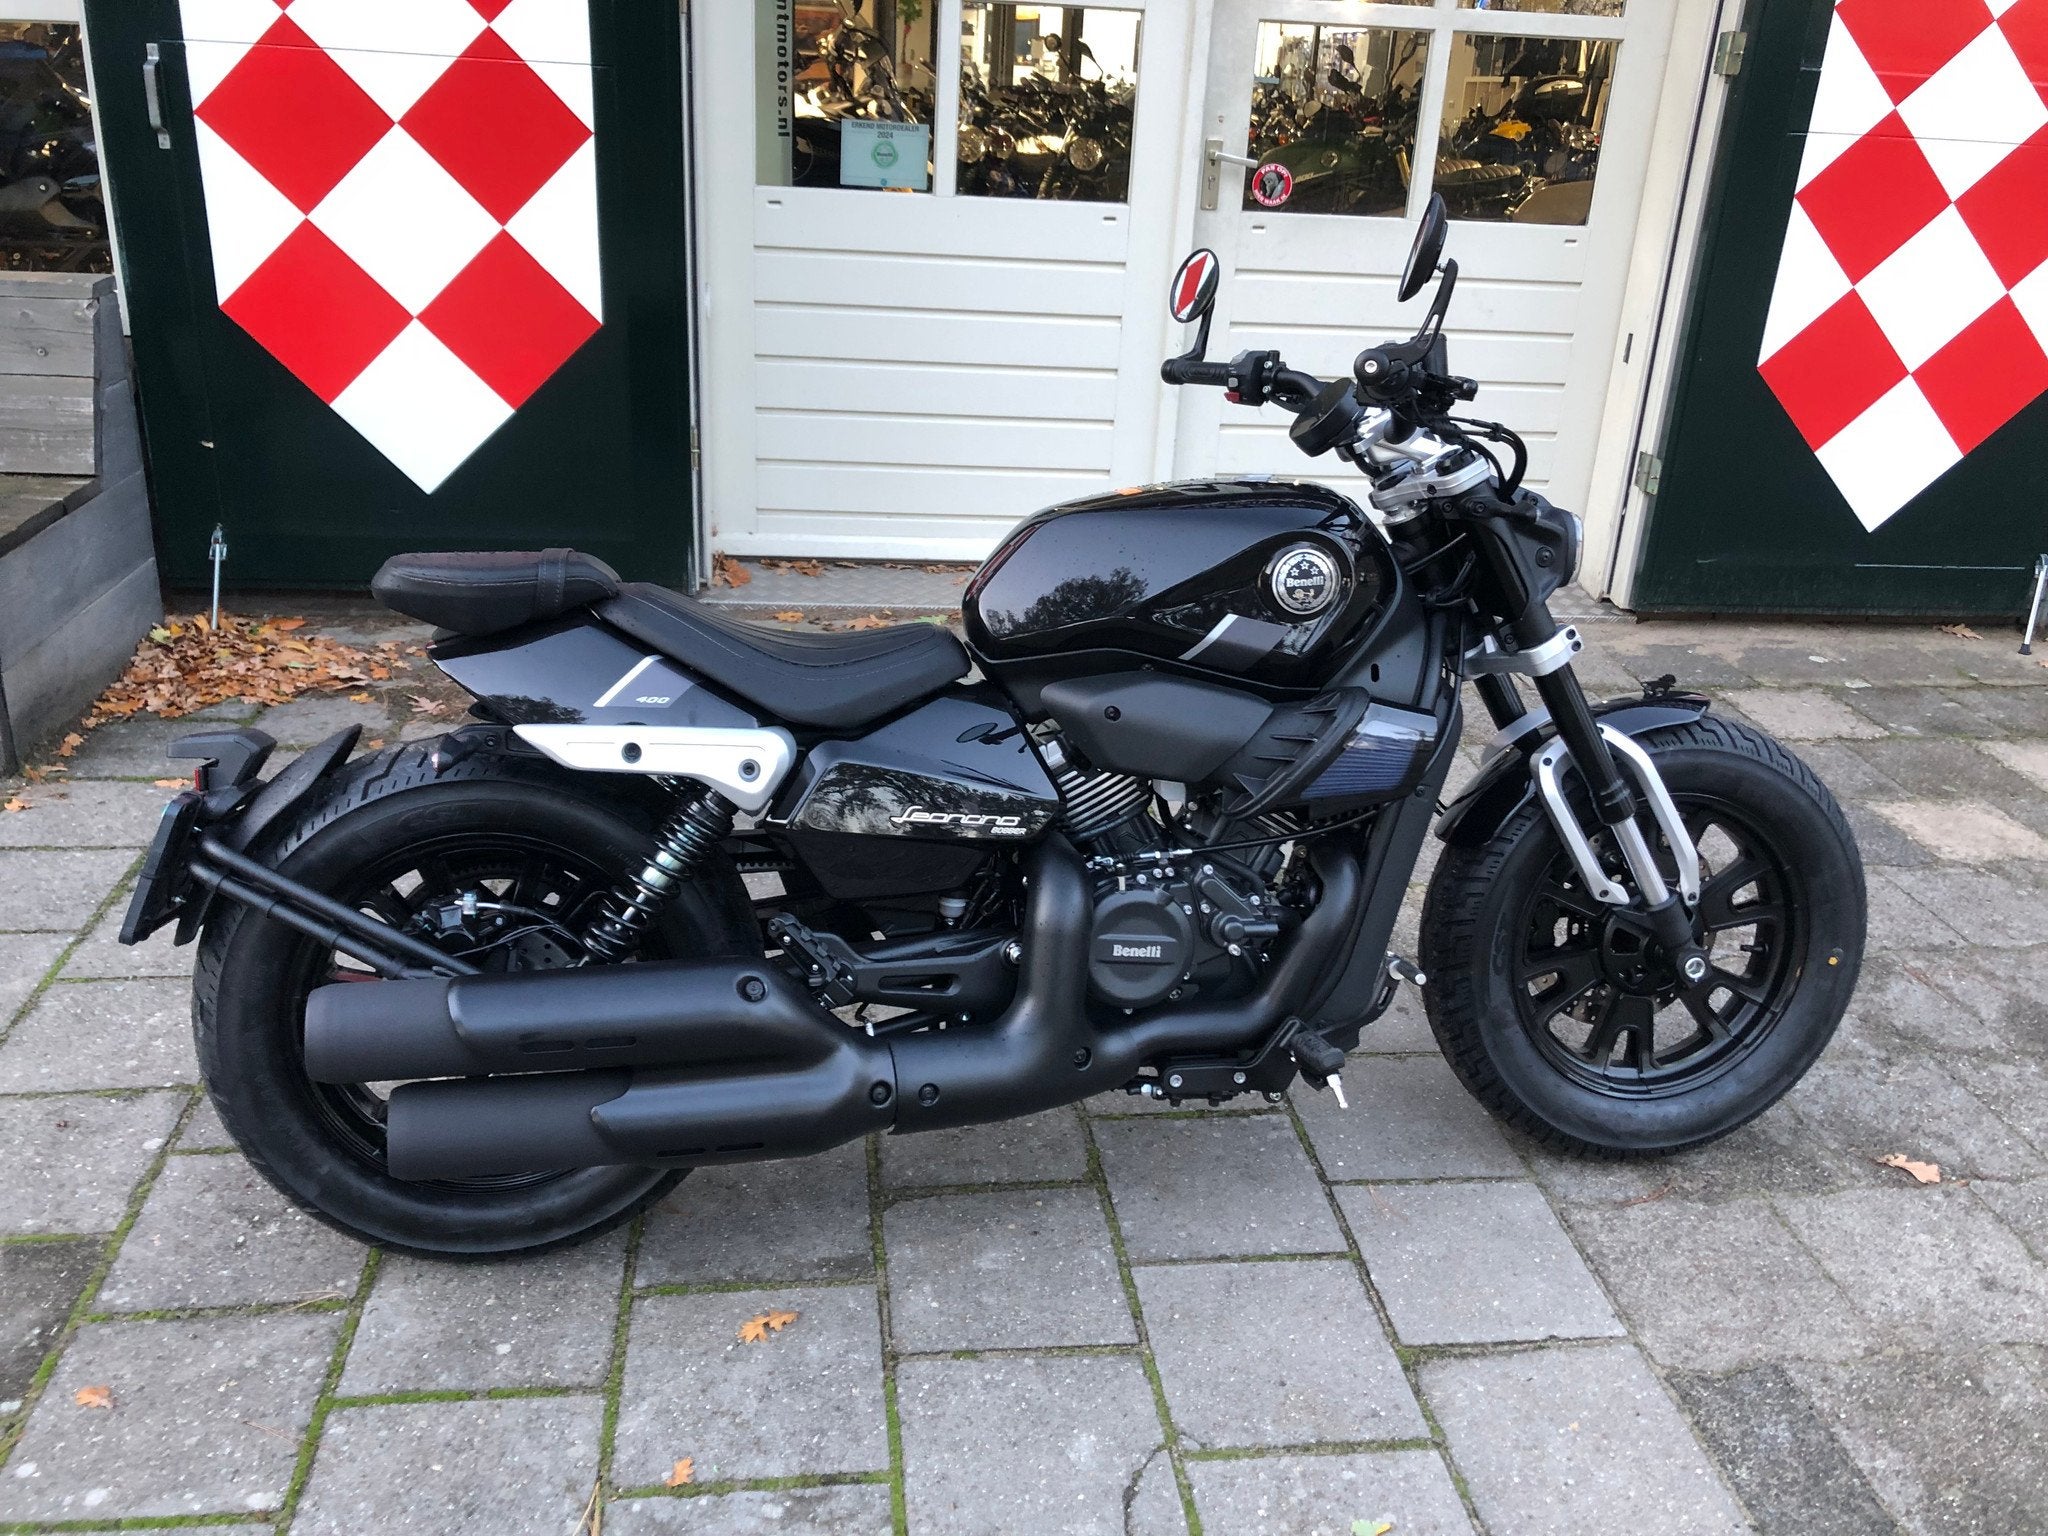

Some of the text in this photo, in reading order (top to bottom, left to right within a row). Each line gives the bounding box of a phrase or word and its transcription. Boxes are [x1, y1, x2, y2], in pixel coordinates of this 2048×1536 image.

[851, 122, 920, 132] ERKEND MOTORDEALER
[876, 131, 894, 139] 2024
[1285, 576, 1324, 588] Benelli
[635, 696, 671, 704] 400
[889, 805, 1021, 827] Leoncino
[990, 827, 1027, 836] BOBBER
[1112, 944, 1162, 958] Benelli
